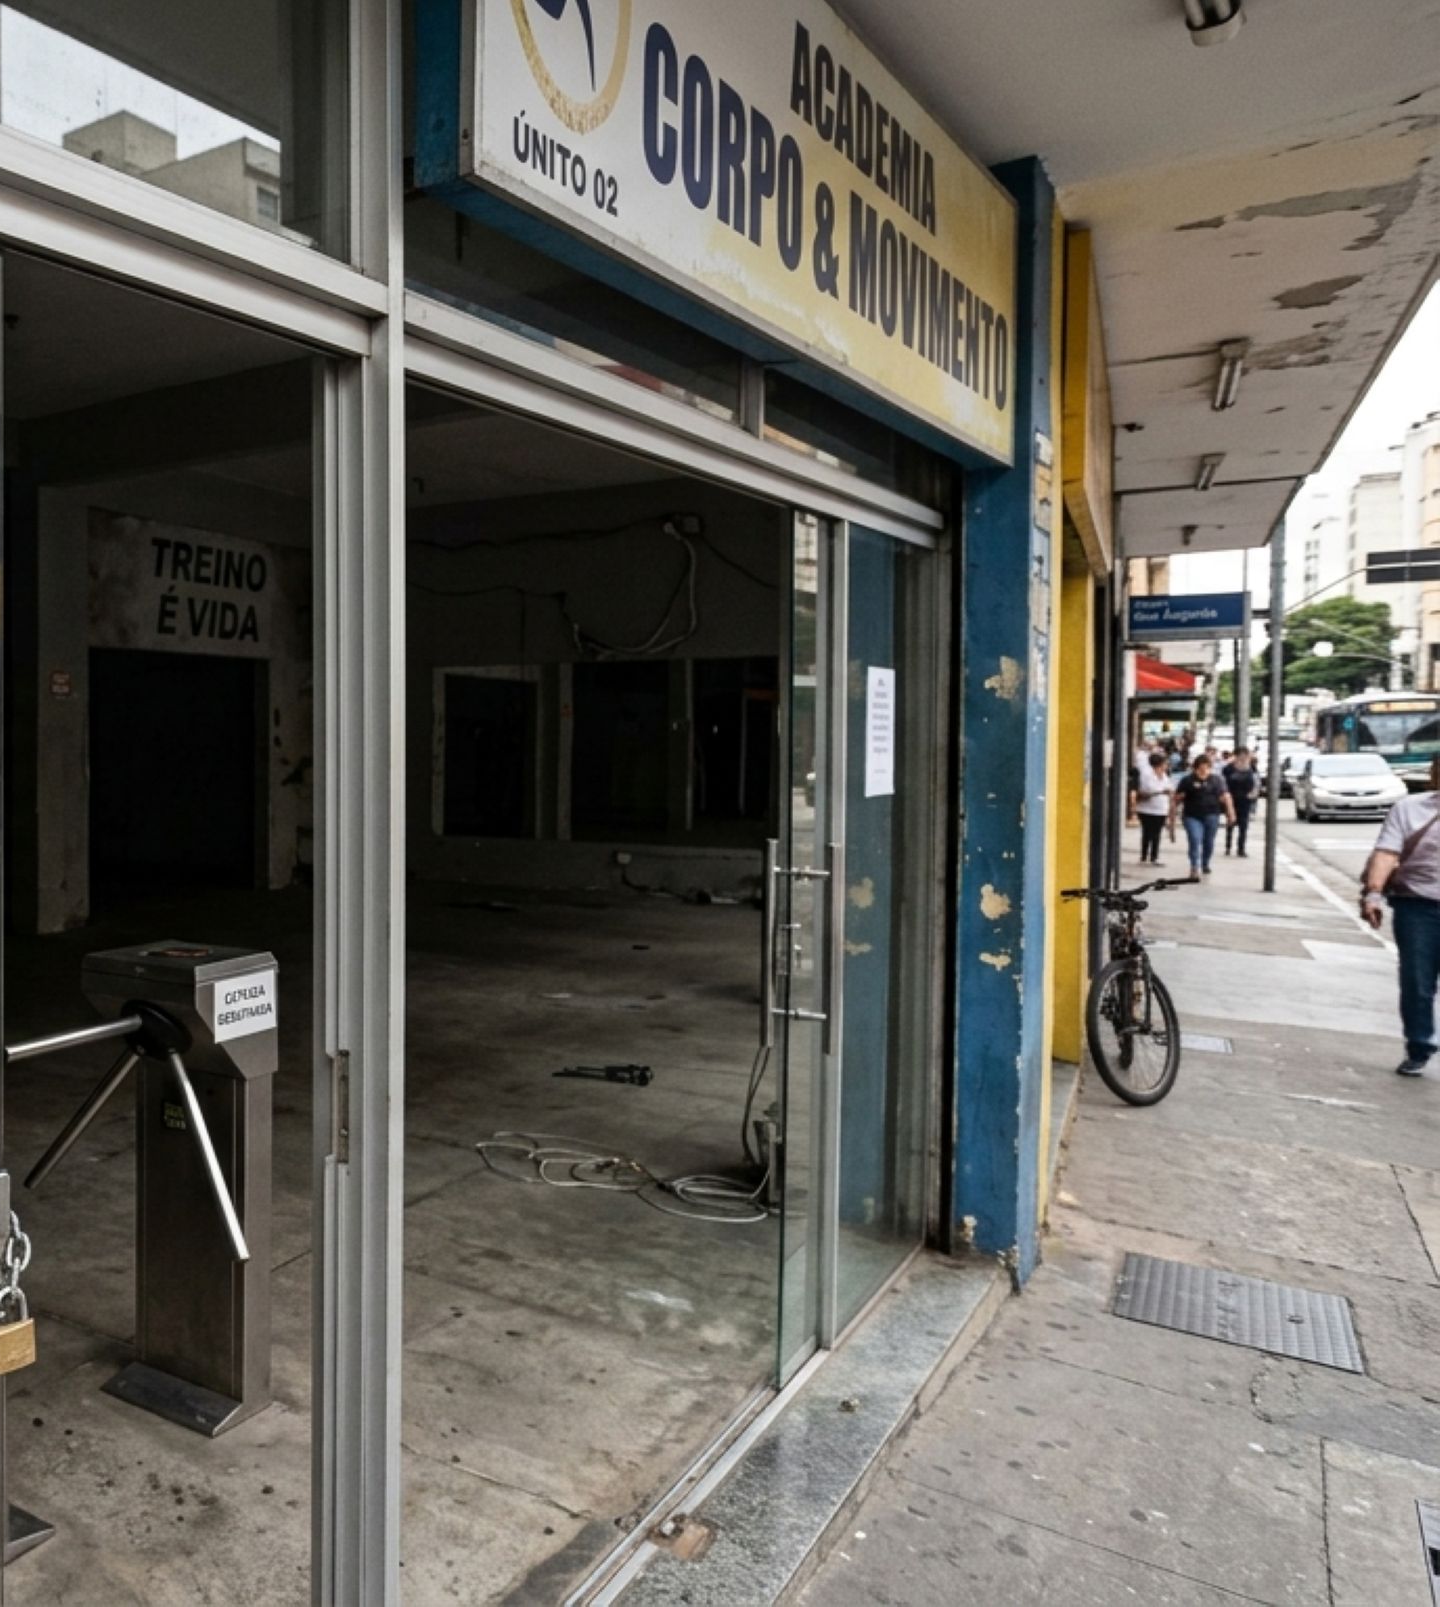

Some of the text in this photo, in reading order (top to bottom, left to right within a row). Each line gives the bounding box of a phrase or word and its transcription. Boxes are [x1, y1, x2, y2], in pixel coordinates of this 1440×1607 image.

[513, 110, 618, 218] ÚNITO 02
[790, 20, 937, 236] ACADEMIA
[643, 22, 1008, 411] CORPO & MOVIMENTO
[152, 537, 267, 592] TREINO
[157, 585, 259, 643] É VIDA
